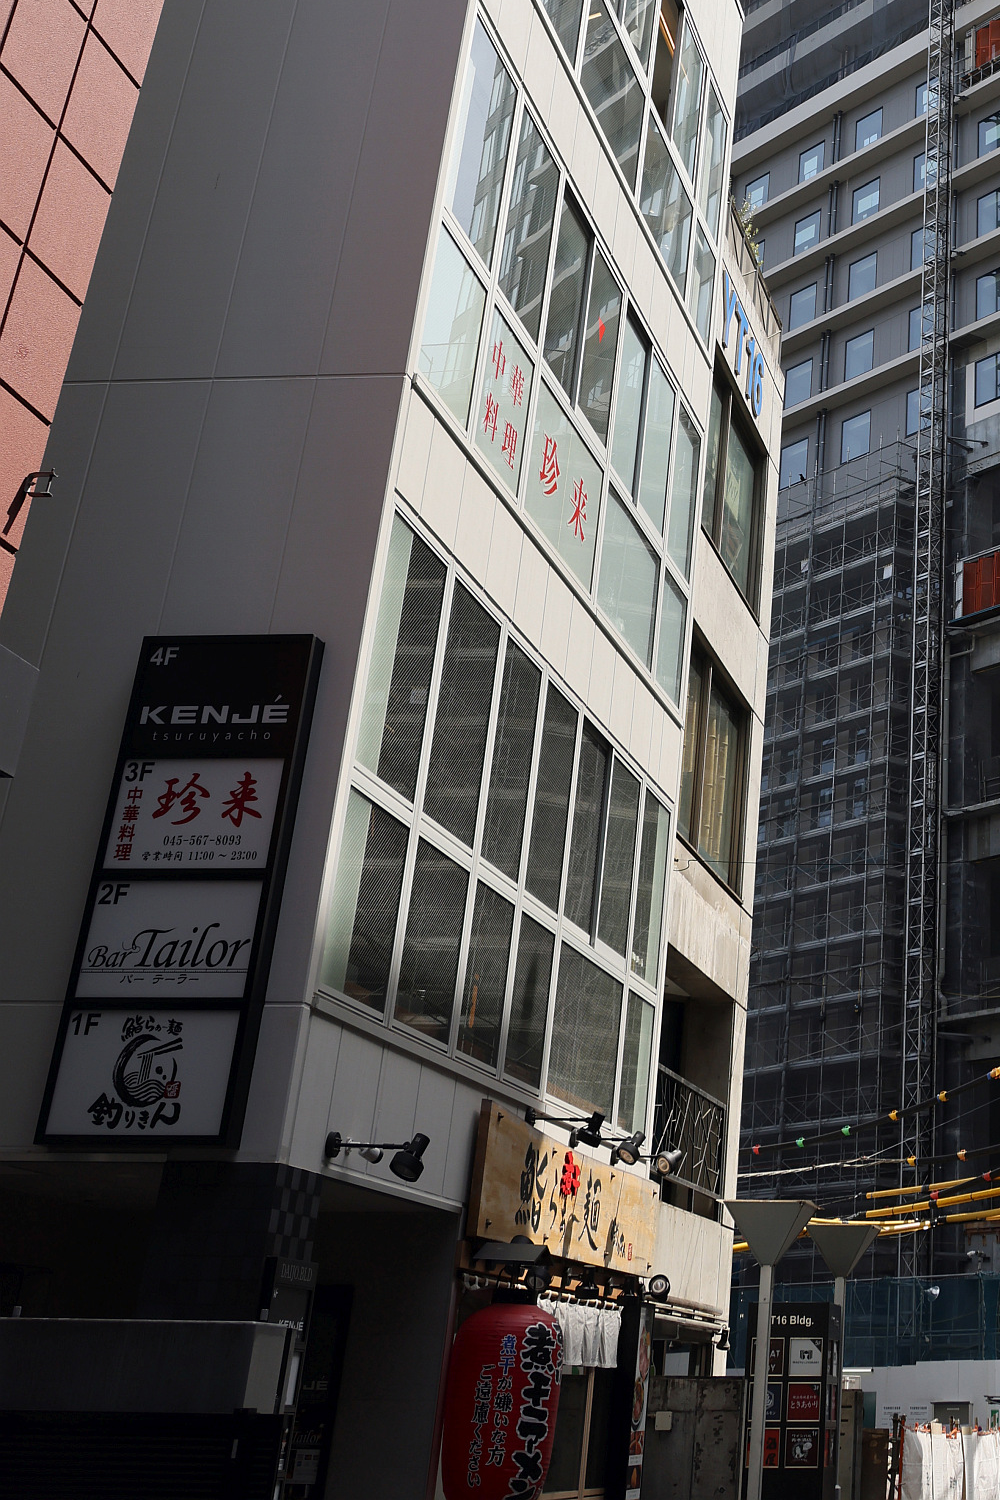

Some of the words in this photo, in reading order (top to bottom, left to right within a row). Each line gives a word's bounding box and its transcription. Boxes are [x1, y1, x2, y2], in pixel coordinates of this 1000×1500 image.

[722, 269, 765, 420] YT16
[149, 646, 180, 666] 4F
[139, 694, 291, 725] KENJÉ
[152, 729, 272, 748] tsuruyacho
[125, 761, 156, 782] 3F
[113, 786, 144, 861] 中華料理
[162, 834, 242, 846] 045-567-8093
[188, 851, 214, 861] 11:00
[231, 851, 257, 861] 23:00
[97, 883, 130, 905] 2F
[87, 944, 133, 968] Bar
[133, 922, 251, 968] Tailor
[152, 973, 199, 985] テーラー
[72, 1013, 101, 1036] 1F
[88, 1092, 181, 1129] 釣りきん
[789, 1315, 815, 1328] Bldg.
[485, 1333, 518, 1468] 煮干が嫌いな方
[466, 1363, 497, 1488] ご遠慮ください
